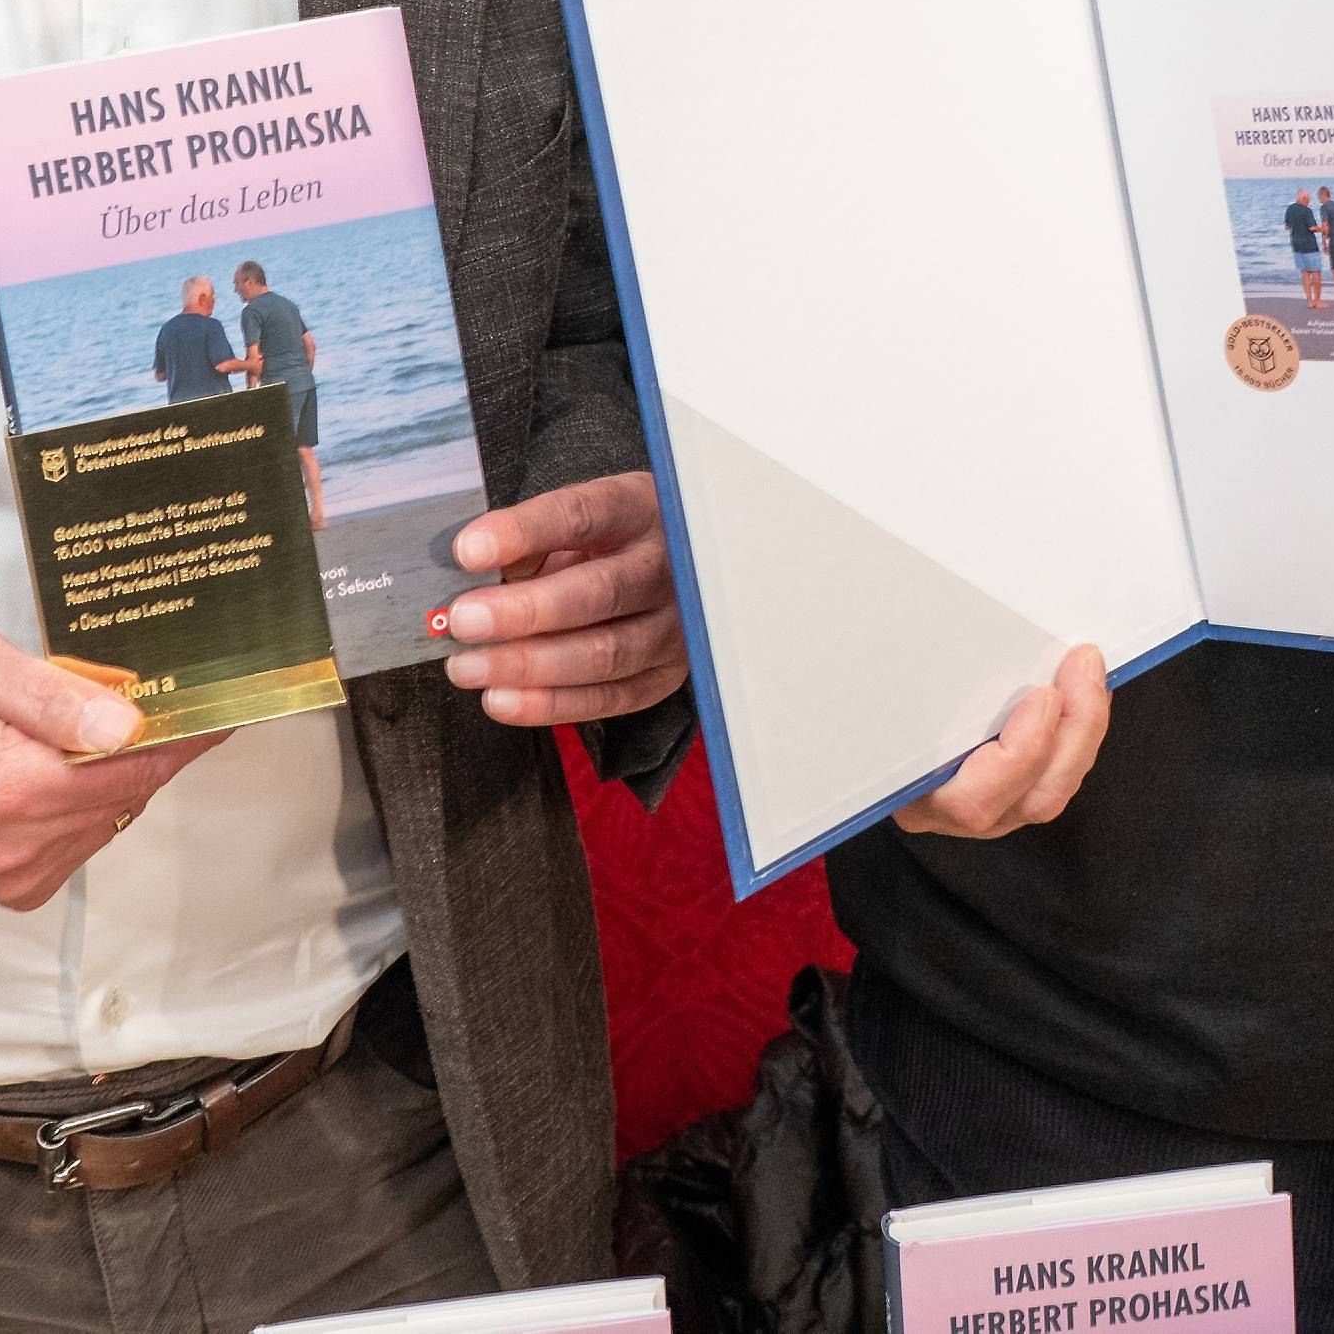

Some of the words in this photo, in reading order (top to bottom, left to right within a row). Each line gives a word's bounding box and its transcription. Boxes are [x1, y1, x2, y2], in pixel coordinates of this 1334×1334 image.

[70, 87, 165, 136] HANS
[175, 61, 313, 117] KRANKL
[1252, 106, 1290, 122] HANS
[28, 139, 174, 198] HERBERT
[186, 104, 372, 170] PROHASKA
[1235, 129, 1294, 145] HERBERT
[1263, 153, 1292, 168] Über
[1295, 154, 1316, 166] das
[100, 204, 172, 239] Über
[180, 195, 229, 224] das
[239, 176, 324, 213] Leben
[73, 427, 162, 458] Hauptverband
[164, 423, 189, 440] des
[183, 424, 265, 453] Buchhandels
[53, 516, 125, 543] Goldenes
[126, 507, 165, 528] Buch
[166, 502, 188, 520] für
[189, 495, 223, 515] mehr
[225, 490, 247, 508] als
[105, 524, 174, 551] verkaufte
[174, 509, 248, 537] Exemplare
[62, 569, 100, 589] Hans
[154, 545, 208, 570] Herbert
[208, 533, 274, 559] Prohaska
[65, 585, 112, 606] Rainer
[180, 565, 207, 583] Eric
[208, 553, 262, 576] Sebach
[320, 566, 348, 581] von
[337, 571, 394, 597] Sebach
[79, 611, 115, 632] Über
[116, 605, 142, 623] das
[142, 597, 185, 618] Leben
[161, 674, 177, 693] a
[994, 1257, 1075, 1296] HANS
[1086, 1241, 1205, 1285] KRANKL
[949, 1302, 1079, 1334] HERBERT
[1088, 1279, 1252, 1328] PROHASKA
